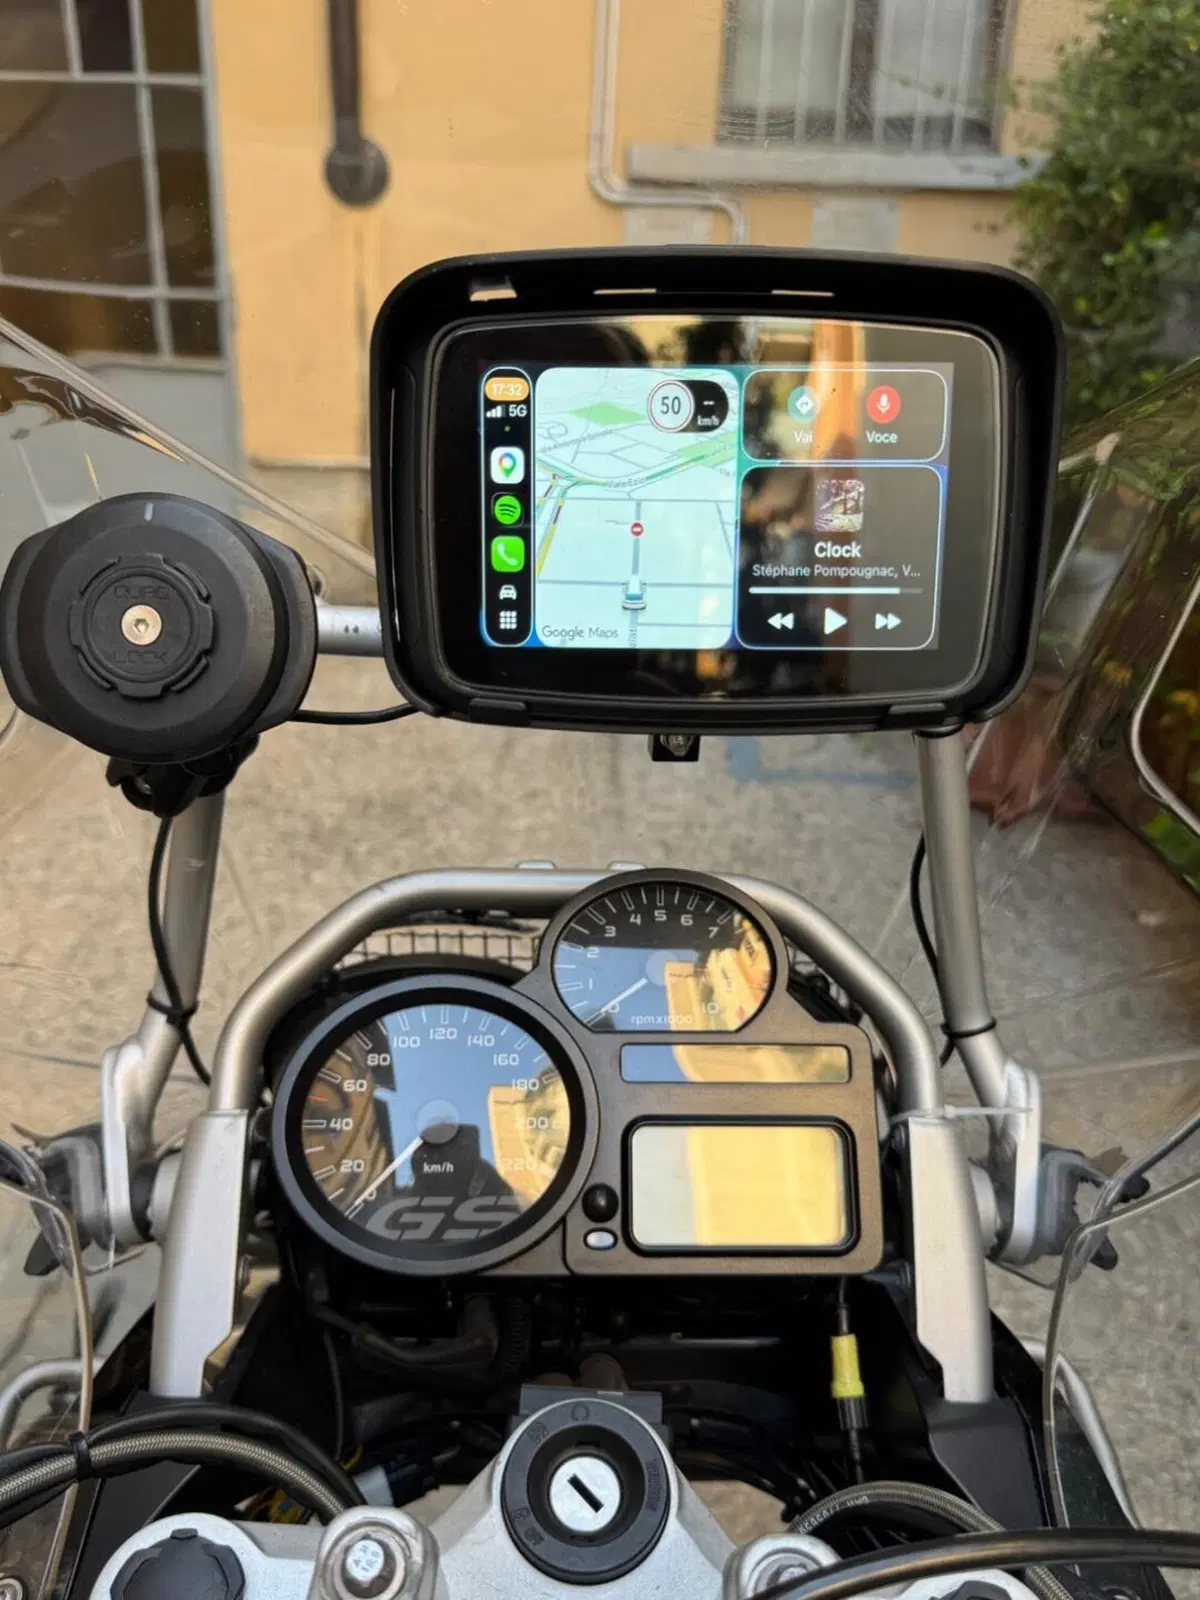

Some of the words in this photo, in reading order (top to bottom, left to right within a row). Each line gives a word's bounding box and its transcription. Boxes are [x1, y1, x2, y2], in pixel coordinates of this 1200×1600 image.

[492, 383, 523, 397] 17:32
[508, 404, 527, 417] 5G
[660, 396, 682, 415] 50
[697, 415, 719, 426] km/h
[794, 431, 814, 443] Vai
[866, 431, 898, 443] Voce
[813, 541, 862, 558] Clock
[751, 564, 811, 578] Stéphane
[813, 565, 899, 579] Pompougnac,
[541, 625, 585, 641] Google
[588, 627, 620, 640] Maps
[629, 914, 641, 925] 4
[654, 909, 667, 921] 5
[680, 914, 693, 926] 6
[604, 925, 616, 938] 3
[708, 926, 719, 938] 7
[587, 947, 599, 958] 2
[702, 1001, 719, 1014] 10
[429, 1027, 457, 1040] 120
[393, 1035, 421, 1049] 100
[467, 1035, 495, 1047] 140
[367, 1053, 391, 1066] 80
[493, 1053, 520, 1066] 160
[343, 1079, 367, 1092] 60
[511, 1077, 539, 1092] 180
[329, 1117, 354, 1130] 40
[340, 1156, 365, 1172] 20
[423, 1161, 454, 1173] km/h
[365, 1195, 524, 1241] GS
